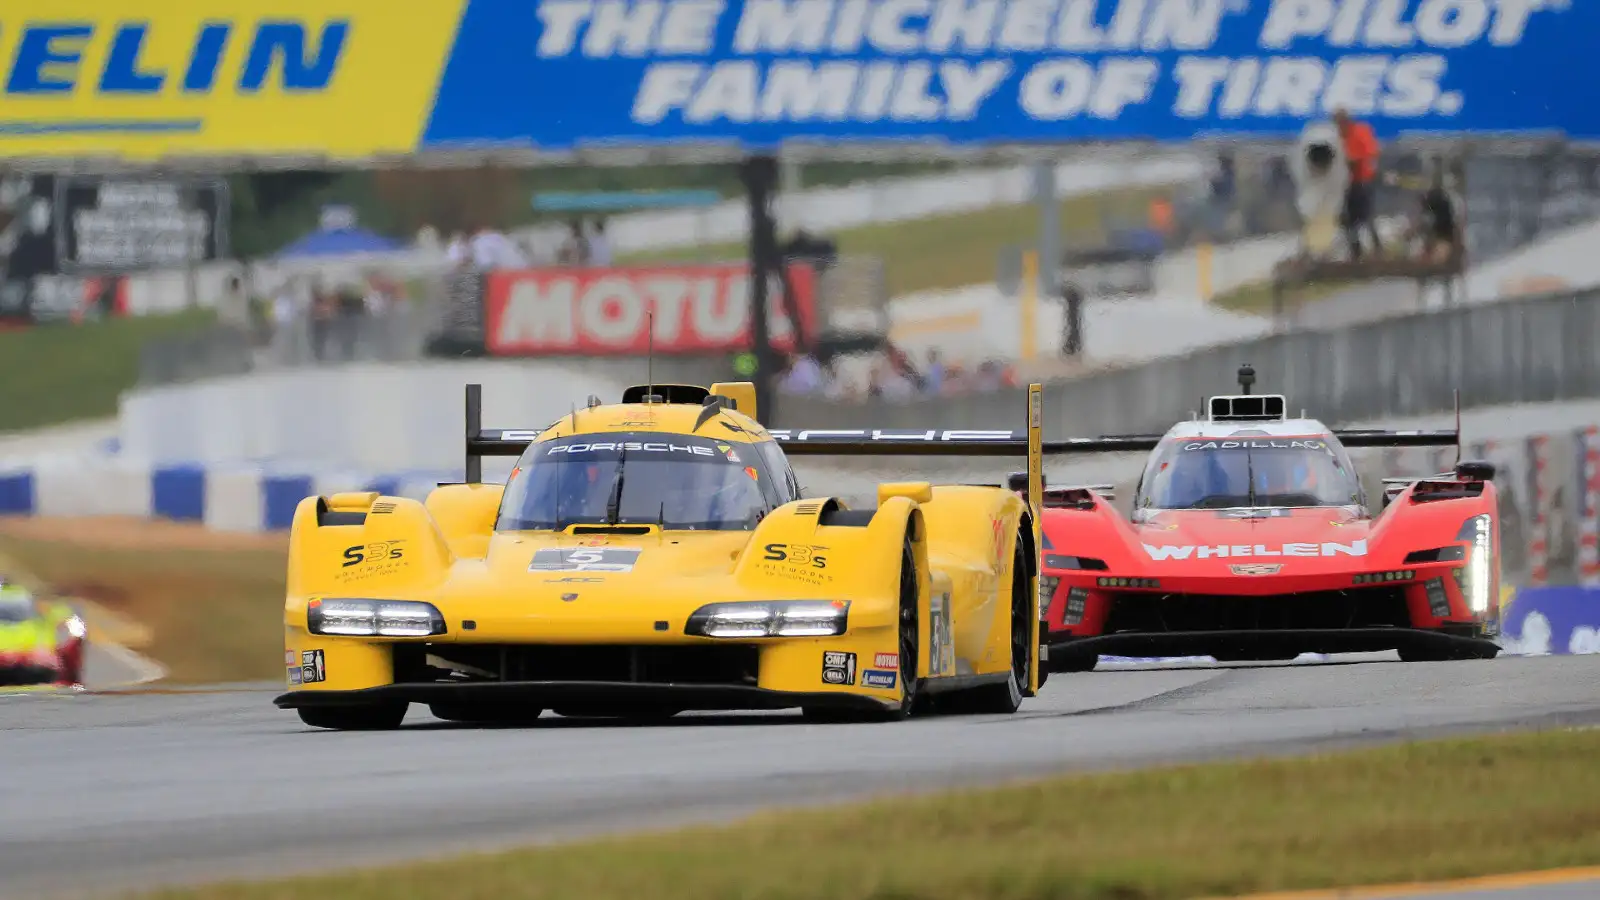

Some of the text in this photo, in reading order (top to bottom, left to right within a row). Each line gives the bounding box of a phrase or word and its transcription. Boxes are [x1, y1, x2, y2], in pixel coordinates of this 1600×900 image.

[536, 0, 1545, 58] THE MICHELIN PILOT
[0, 21, 350, 94] ELIN
[632, 54, 1463, 124] FAMILY OF TIRES.
[547, 441, 716, 457] PORSCHE
[1183, 440, 1320, 452] CADILLAC
[564, 549, 604, 564] 5
[1142, 538, 1367, 561] WHELEN
[825, 654, 846, 666] OMP
